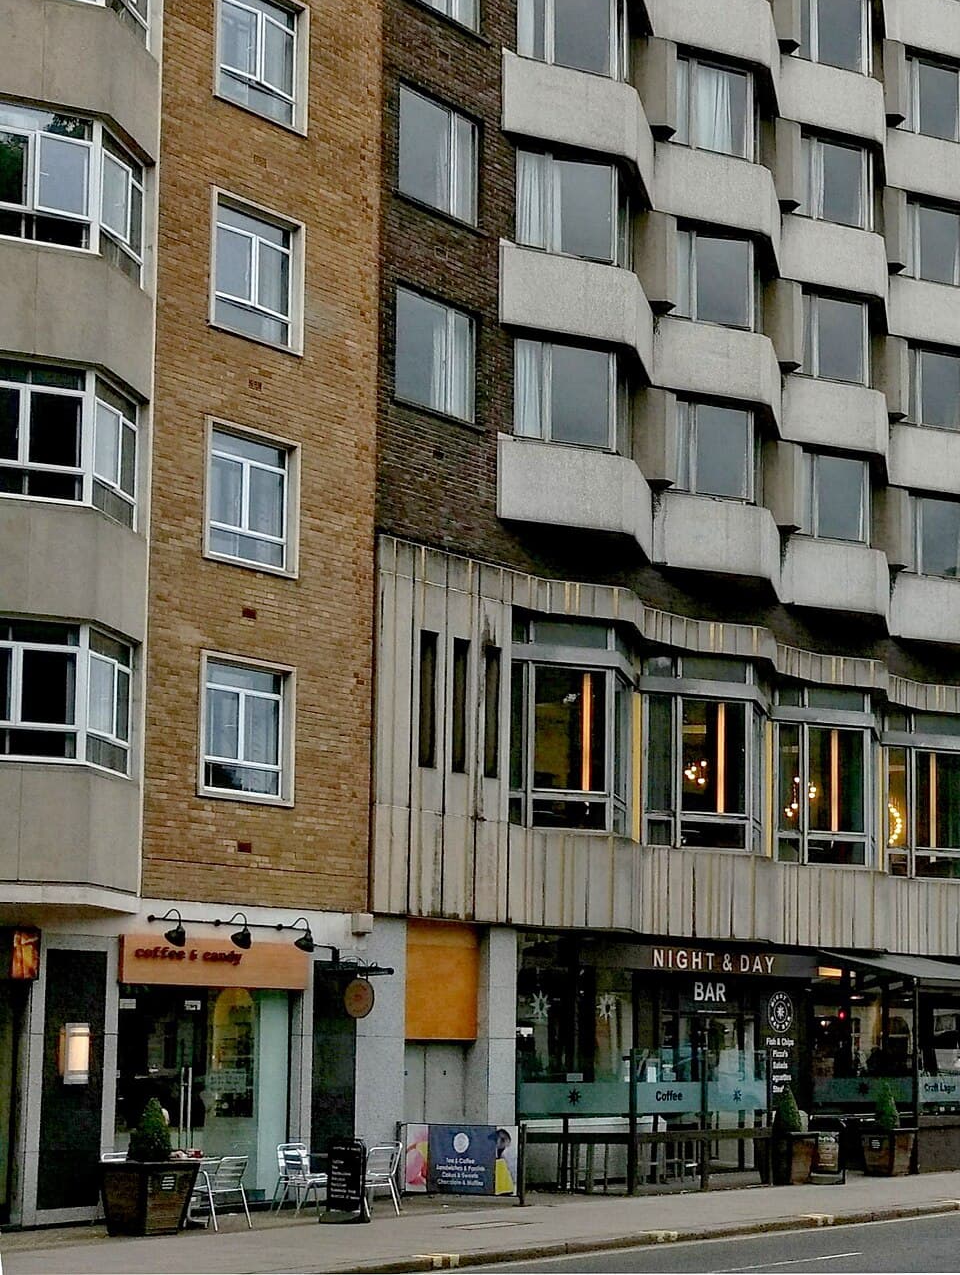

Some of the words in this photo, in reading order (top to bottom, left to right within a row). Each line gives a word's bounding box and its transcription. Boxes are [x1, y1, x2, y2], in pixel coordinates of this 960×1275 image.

[134, 946, 186, 960] coffee
[202, 950, 243, 966] candy
[652, 949, 715, 971] NIGHT
[722, 953, 733, 972] &
[740, 955, 776, 974] DAY
[694, 981, 727, 1003] BAR
[766, 1037, 776, 1046] Fish
[781, 1037, 795, 1047] Chips
[655, 1090, 683, 1102] Coffee
